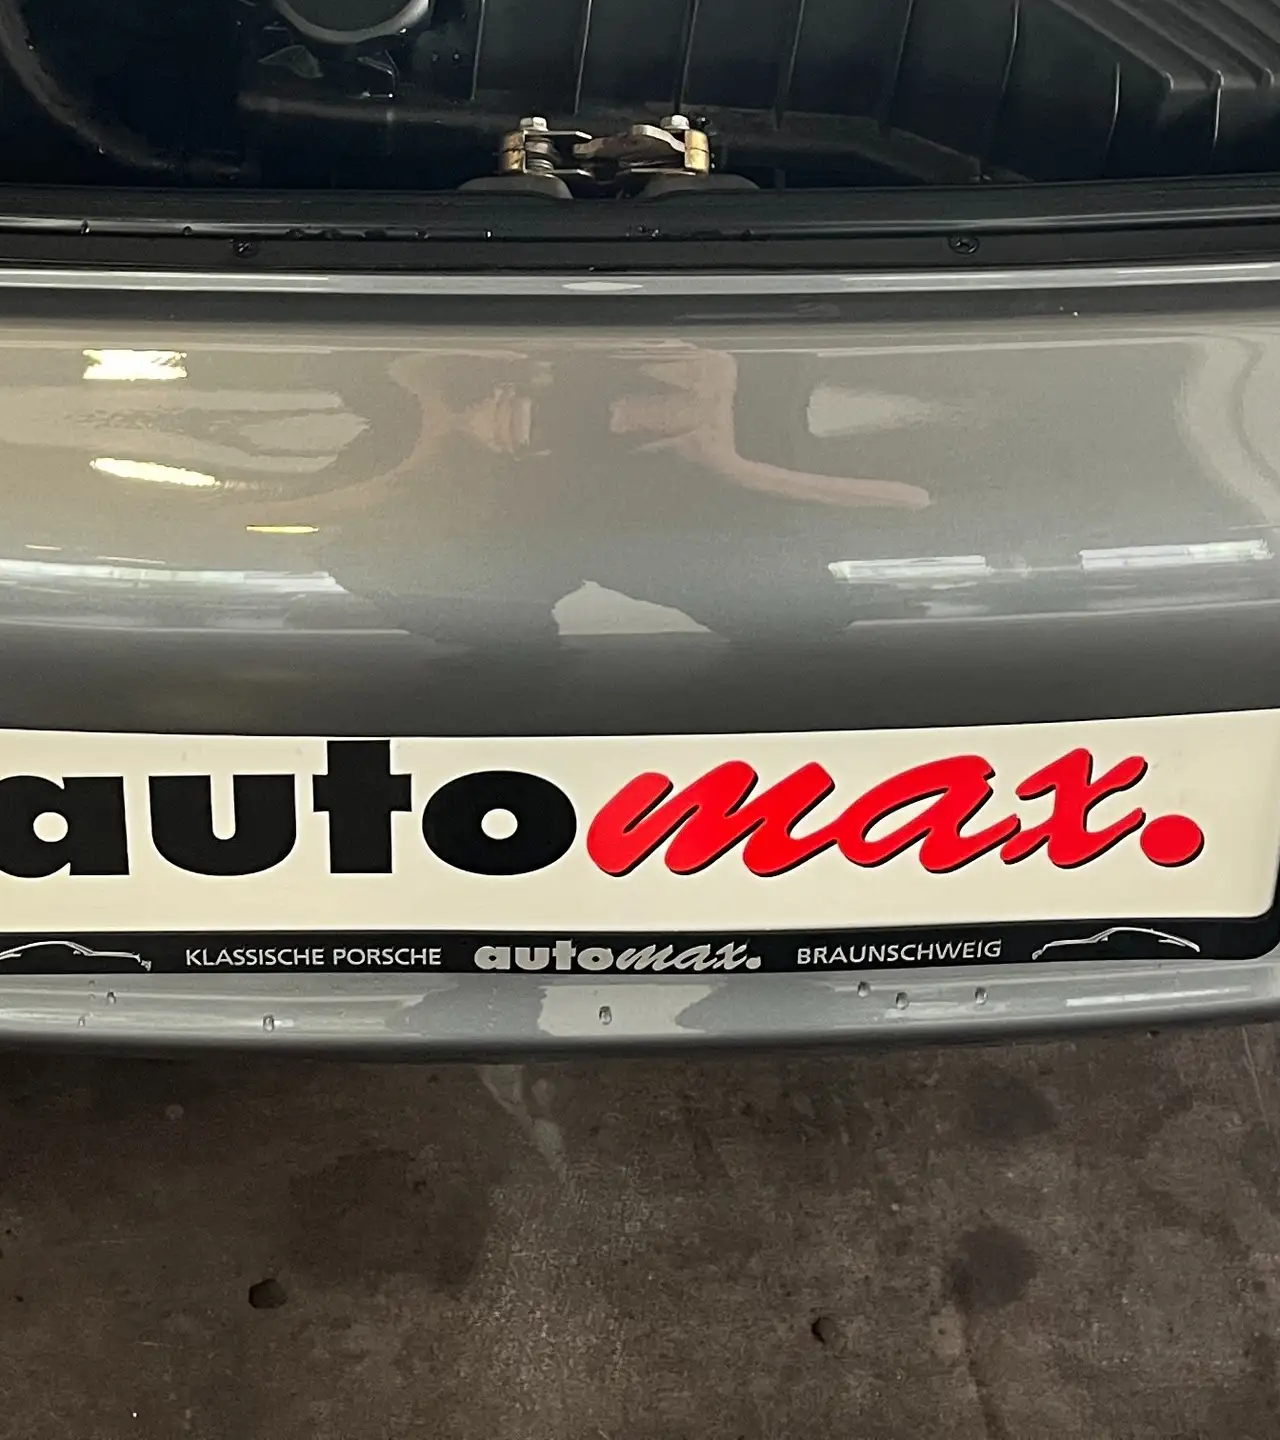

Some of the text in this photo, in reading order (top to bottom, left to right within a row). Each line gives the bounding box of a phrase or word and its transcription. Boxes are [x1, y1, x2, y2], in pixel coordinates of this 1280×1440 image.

[184, 938, 1003, 972] KLASSISCHE PORSCHE automax. BRAUNSCHWEIG
